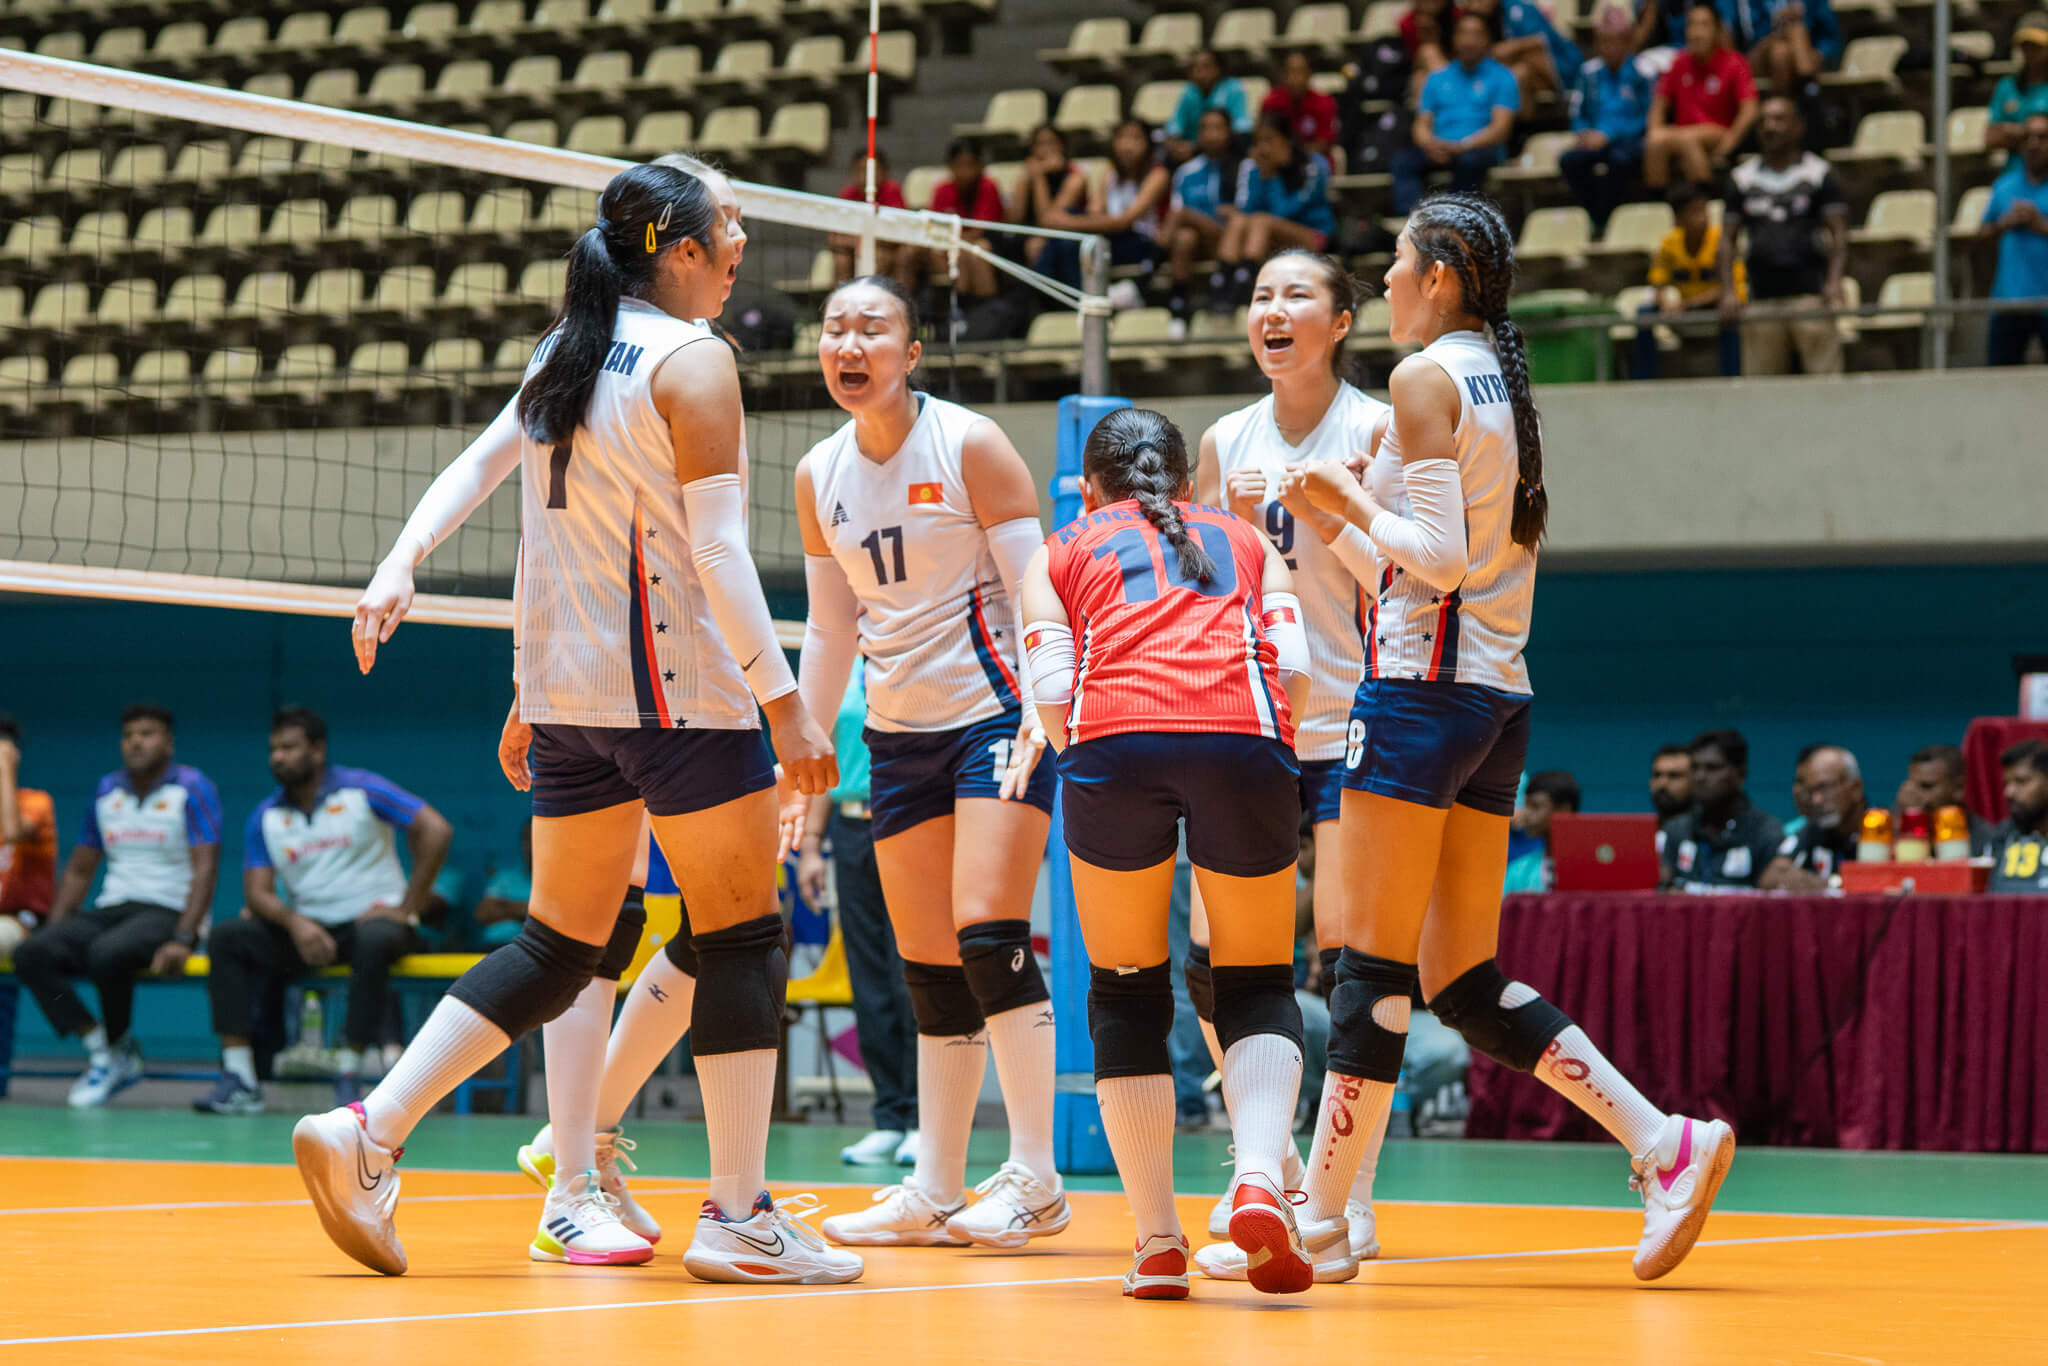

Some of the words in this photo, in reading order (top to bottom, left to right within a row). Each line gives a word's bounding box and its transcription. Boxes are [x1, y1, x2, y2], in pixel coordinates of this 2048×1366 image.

[1266, 500, 1294, 555] 9
[861, 525, 907, 586] 17
[1346, 719, 1366, 769] 8
